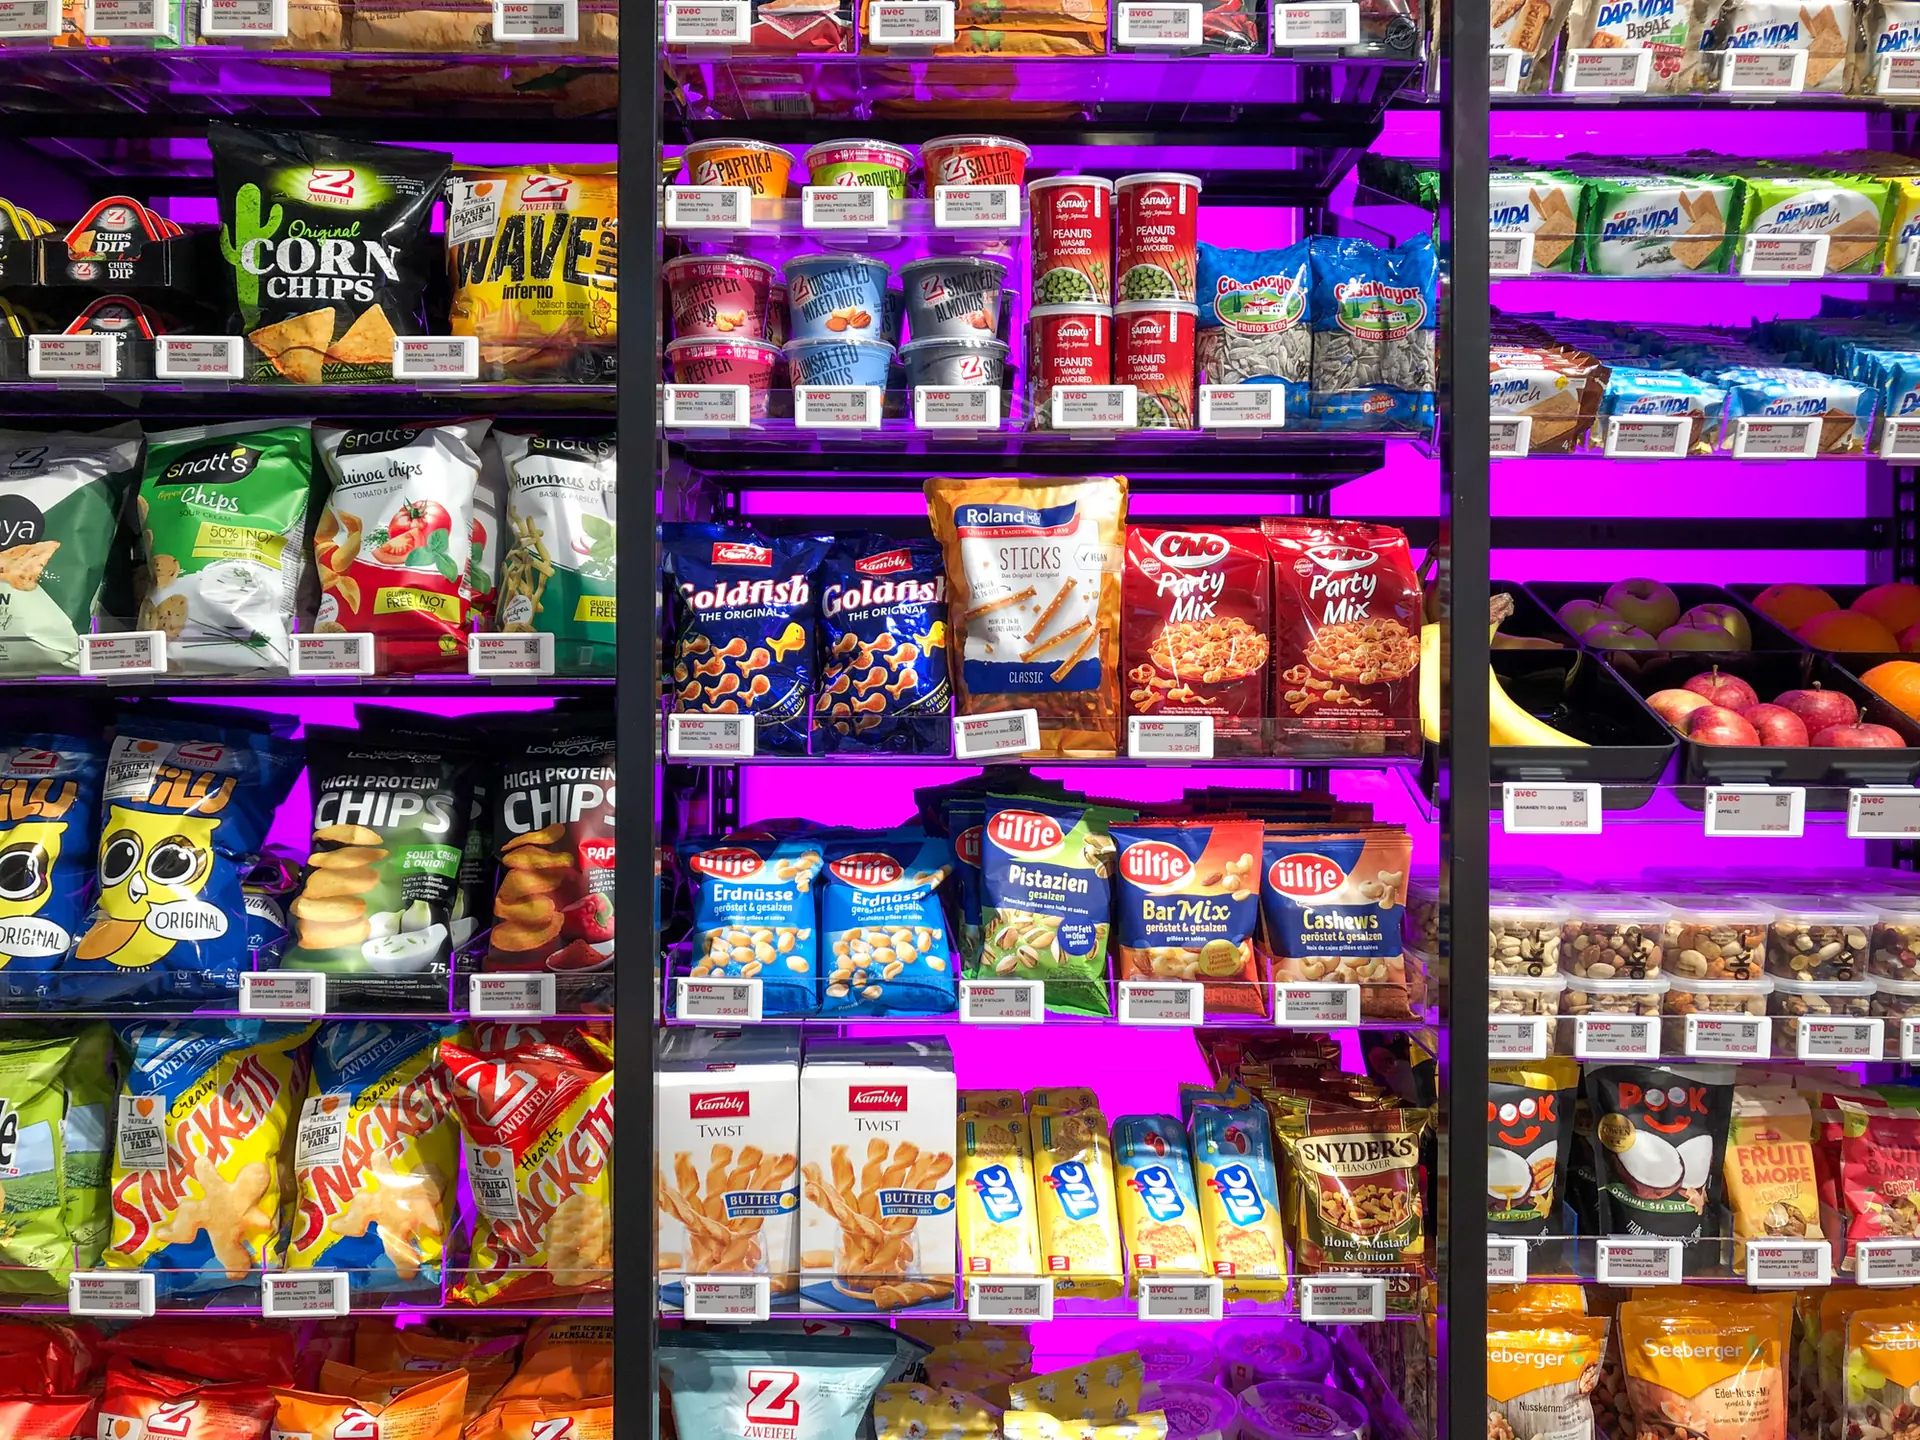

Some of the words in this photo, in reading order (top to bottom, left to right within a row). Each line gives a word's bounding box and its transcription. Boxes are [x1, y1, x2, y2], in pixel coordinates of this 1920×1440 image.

[677, 7, 702, 15] avec
[718, 152, 773, 183] PAPRIKA
[966, 151, 1012, 179] SALTED
[677, 192, 702, 200] avec
[1139, 196, 1171, 206] SAITAKU
[519, 202, 566, 212] ZWEIFEL
[1056, 199, 1088, 209] SAITAKU
[454, 205, 492, 223] PAPRIKA
[461, 216, 484, 229] FANS
[97, 233, 132, 242] CHIPS
[288, 219, 361, 247] Original
[1053, 229, 1092, 239] PEANUTS
[1136, 226, 1175, 236] PEANUTS
[96, 241, 131, 252] DIP
[1060, 239, 1084, 247] WASABI
[1142, 236, 1168, 244] WASABI
[458, 213, 598, 290] WAVE
[1053, 248, 1091, 256] FLAVOURED
[1136, 244, 1174, 253] FLAVOURED
[108, 262, 134, 271] CHIPS
[241, 237, 401, 282] CORN
[109, 269, 134, 279] DIP
[808, 263, 870, 297] UNSALTED
[267, 277, 380, 302] CHIPS
[946, 269, 993, 297] SMOKED
[502, 284, 553, 300] inferno
[566, 301, 590, 310] scharf
[801, 292, 834, 324] MIXED
[833, 287, 865, 312] NUTS
[934, 292, 984, 324] ALMONDS
[1238, 321, 1265, 332] FRUTOS
[1266, 320, 1288, 331] SECOS
[1211, 392, 1234, 400] avec
[1362, 400, 1394, 413] Damel
[167, 447, 248, 479] snatt's
[388, 461, 423, 480] chips
[181, 485, 239, 513] Chips
[353, 488, 382, 499] TOMATO
[967, 508, 1024, 524] Roland
[210, 526, 239, 539] 50%
[246, 530, 276, 545] NOT
[1000, 546, 1061, 571] STICKS
[1090, 553, 1108, 562] VEGAN
[1156, 569, 1226, 598] Party
[1309, 572, 1378, 600] Party
[419, 595, 446, 608] NOT
[590, 607, 616, 617] FREE
[699, 611, 725, 622] THE
[727, 607, 778, 621] ORIGINAL
[848, 611, 871, 622] THE
[872, 605, 926, 618] ORIGINAL
[1169, 596, 1218, 624] Mix
[1322, 597, 1371, 625] Mix
[480, 640, 505, 648] avec
[1009, 671, 1044, 684] CLASSIC
[1139, 722, 1165, 731] avec
[321, 775, 359, 790] HIGH
[364, 776, 440, 790] PROTEIN
[1716, 794, 1741, 802] avec
[314, 790, 454, 834] CHIPS
[997, 813, 1055, 849] ültje
[406, 850, 434, 860] SOUR
[403, 860, 410, 868] &
[414, 859, 446, 868] ONION
[699, 854, 756, 876] ültje
[1129, 848, 1184, 881] ültje
[1009, 864, 1088, 894] Pistazien
[1278, 861, 1337, 893] ültje
[714, 884, 794, 902] Erdnüsse
[1028, 890, 1066, 903] gesalzen
[714, 902, 748, 915] geröstet
[748, 903, 756, 912] &
[756, 902, 793, 915] gesalzen
[1142, 899, 1176, 921] Bar
[1177, 899, 1231, 924] Mix
[156, 912, 221, 931] ORIGINAL
[1303, 909, 1379, 930] Cashews
[1061, 925, 1078, 933] ohne
[1079, 925, 1092, 933] Fett
[1072, 932, 1086, 940] Ofen
[1145, 923, 1180, 935] geröstet
[1182, 923, 1190, 932] &
[1190, 922, 1228, 935] gesalzen
[1300, 931, 1337, 944] geröstet
[1338, 931, 1345, 941] &
[1346, 931, 1383, 944] gesalzen
[250, 979, 276, 987] avec
[1587, 1023, 1612, 1031] avec
[148, 1035, 216, 1089] ZWEIFEL
[170, 1079, 218, 1119] Cream
[695, 1096, 745, 1112] Kambly
[854, 1090, 902, 1107] Kambly
[494, 1086, 552, 1142] ZWEIFEL
[697, 1124, 744, 1138] TWIST
[855, 1117, 902, 1132] TWIST
[122, 1129, 158, 1142] PAPRIKA
[130, 1139, 152, 1150] FANS
[519, 1127, 563, 1171] Hearts
[1302, 1138, 1413, 1164] SNYDER'S
[1736, 1144, 1809, 1167] FRUIT
[1342, 1158, 1391, 1173] HANOVER
[983, 1169, 1020, 1218] TUC
[1059, 1165, 1097, 1216] TUC
[1143, 1169, 1182, 1217] TUC
[1222, 1170, 1262, 1222] TUC
[730, 1194, 778, 1206] BUTTER
[884, 1192, 932, 1205] BUTTER
[1611, 1187, 1645, 1208] ORIGINAL
[1650, 1201, 1665, 1211] SEA
[1668, 1203, 1687, 1211] SALT
[1324, 1236, 1362, 1251] Honey
[1366, 1235, 1410, 1249] Mustard
[1344, 1252, 1354, 1261] &
[1357, 1250, 1394, 1261] Onion
[1643, 1337, 1744, 1363] Seeberger
[743, 1426, 798, 1440] ZWEIFEL
